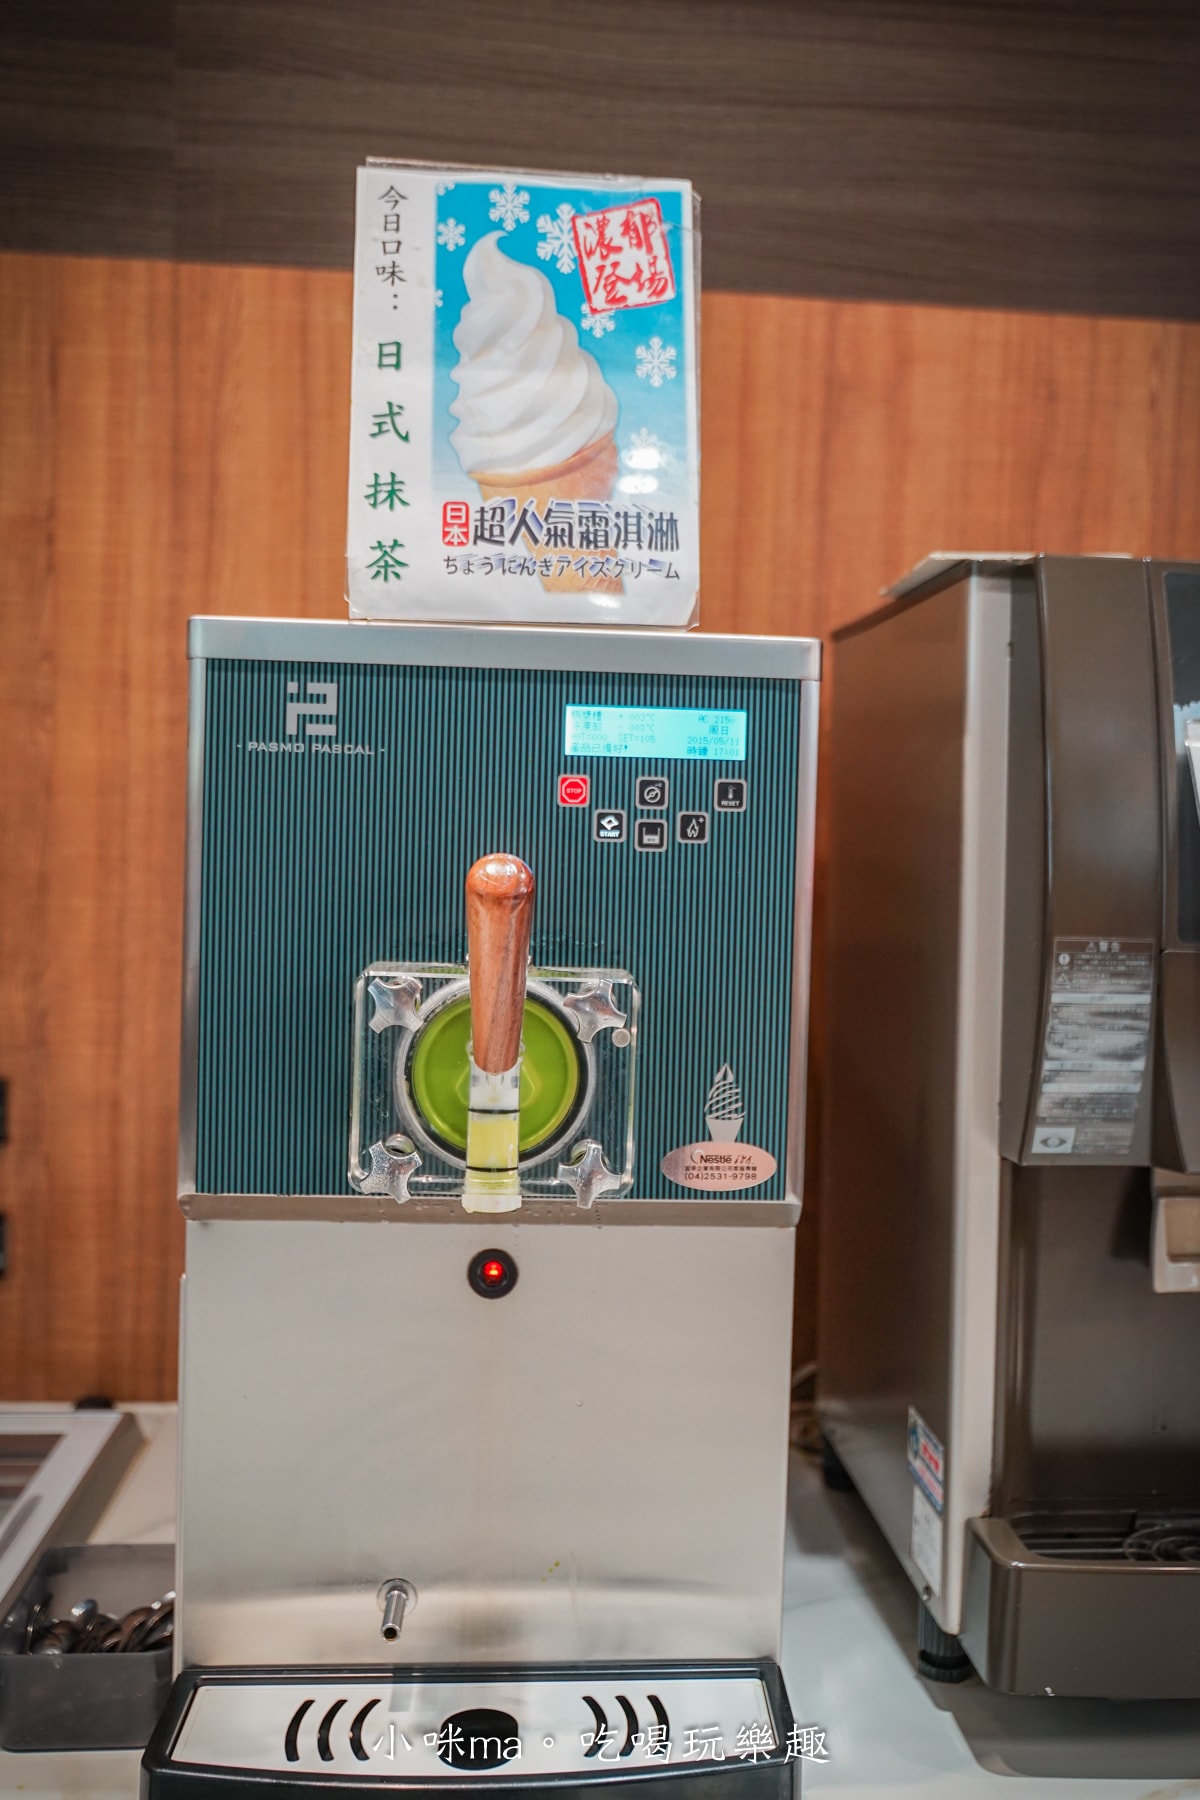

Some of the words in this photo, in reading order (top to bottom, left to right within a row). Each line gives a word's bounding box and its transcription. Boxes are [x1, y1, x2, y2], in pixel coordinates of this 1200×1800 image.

[364, 341, 411, 583] 日式抹茶
[443, 504, 468, 545] 日本
[473, 505, 681, 553] 超人氣霜淇淋
[247, 741, 305, 753] PASMO
[312, 743, 376, 755] PASCAL
[566, 787, 583, 795] STOP
[721, 800, 740, 808] RESET
[599, 830, 621, 839] START
[684, 1172, 757, 1181] (04)2531-9798
